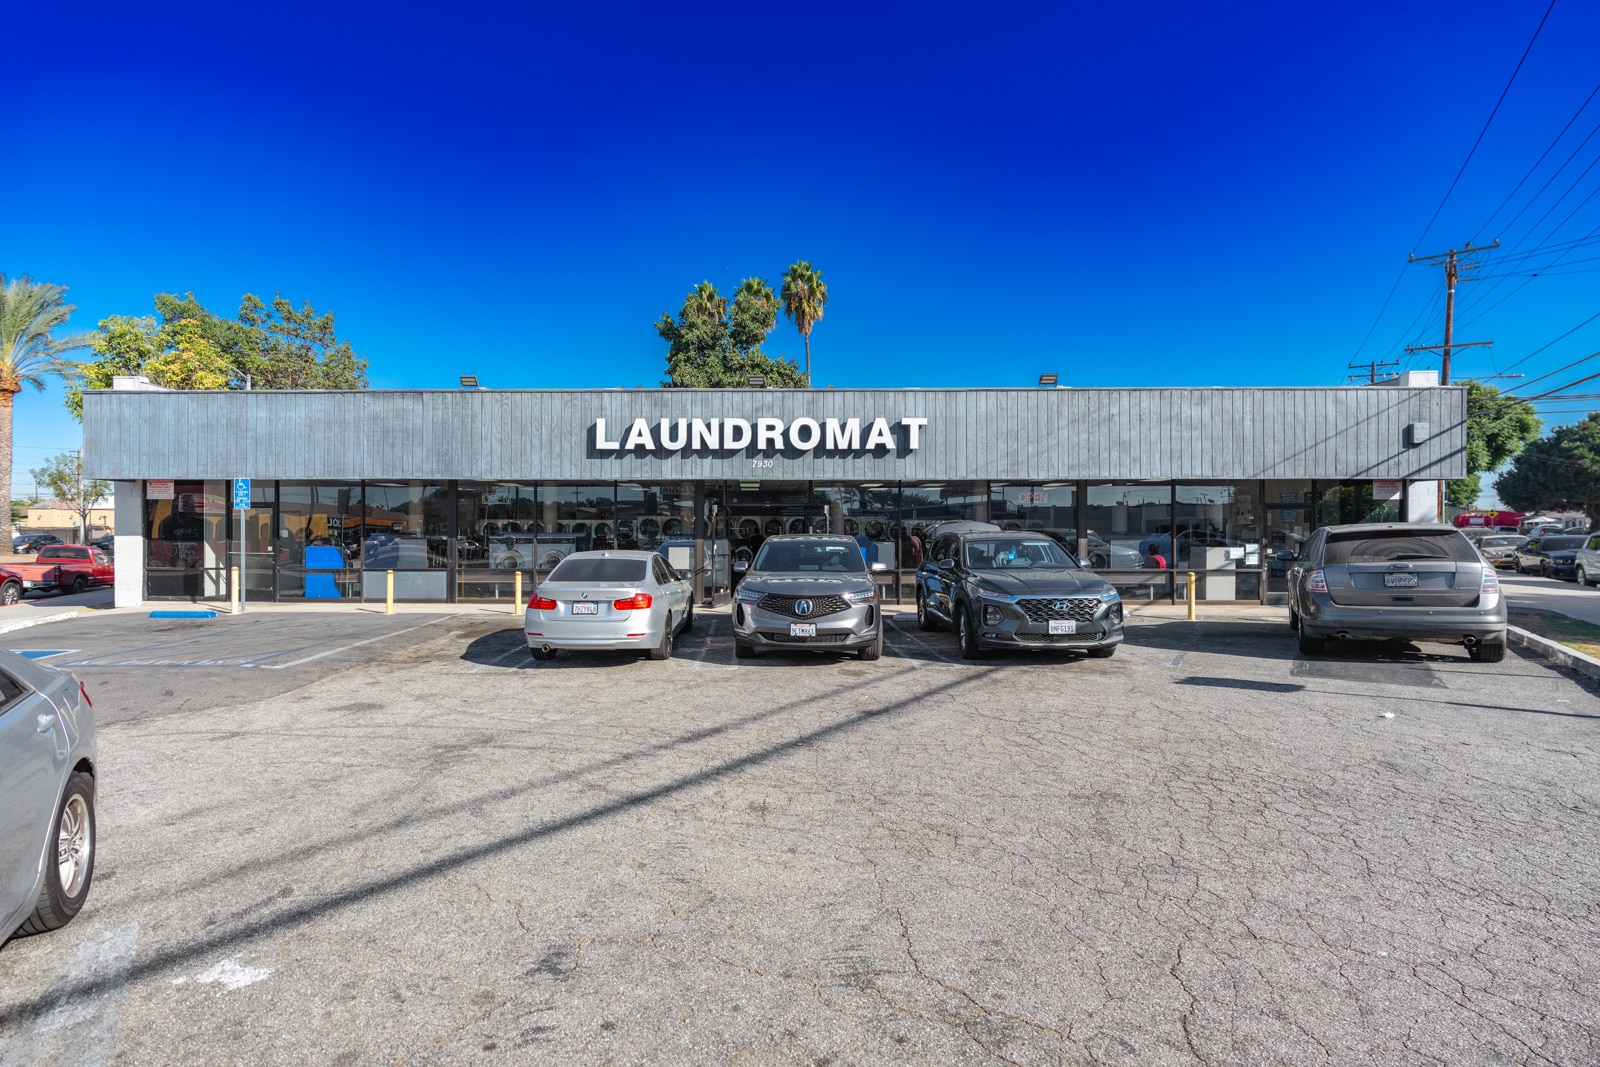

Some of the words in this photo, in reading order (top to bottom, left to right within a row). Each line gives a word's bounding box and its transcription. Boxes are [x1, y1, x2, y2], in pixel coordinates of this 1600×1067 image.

[595, 417, 928, 450] LAUNDROMAT
[752, 460, 774, 468] 7930
[1019, 492, 1047, 503] OPEN
